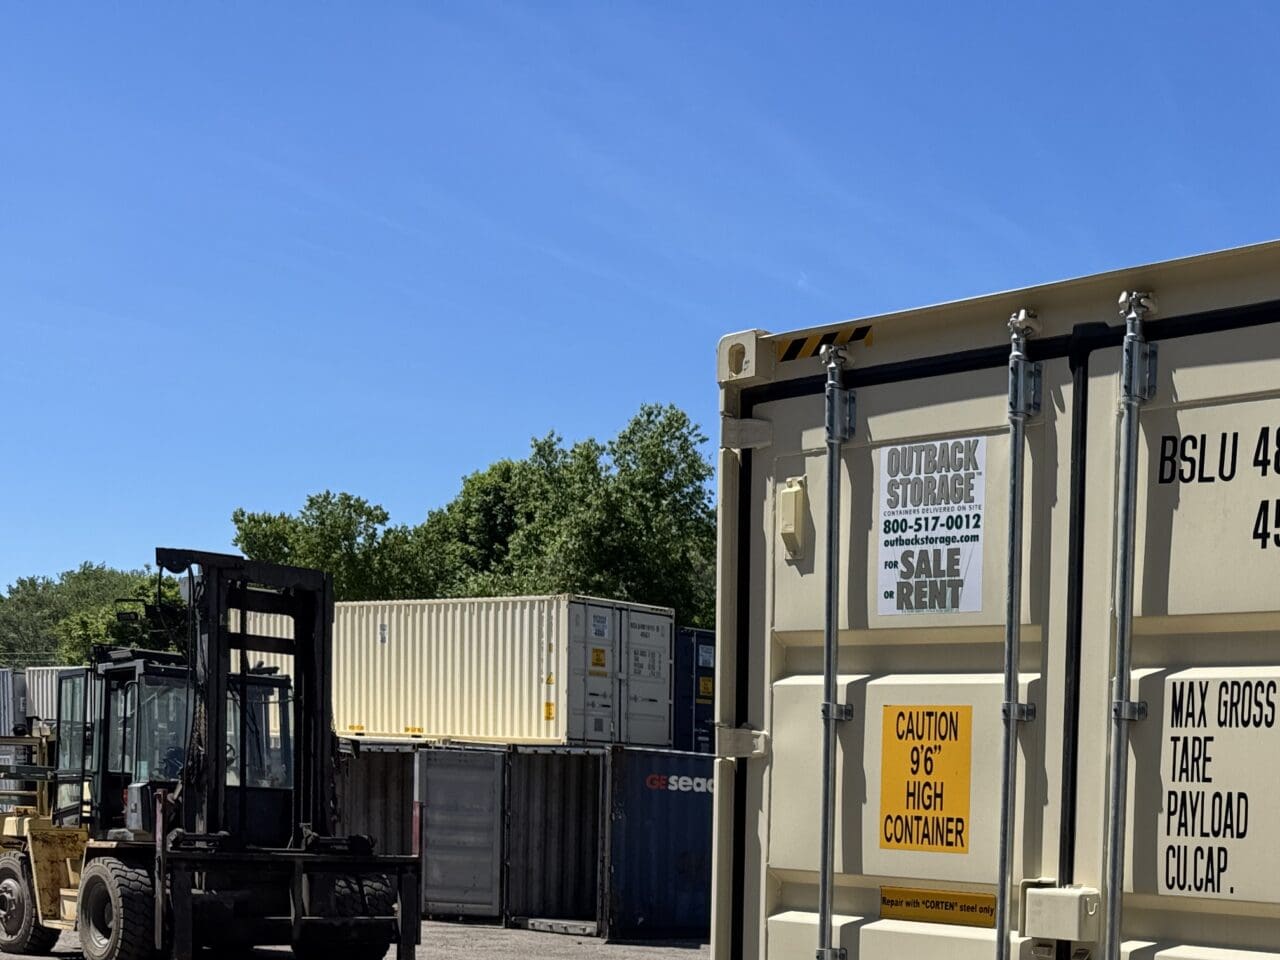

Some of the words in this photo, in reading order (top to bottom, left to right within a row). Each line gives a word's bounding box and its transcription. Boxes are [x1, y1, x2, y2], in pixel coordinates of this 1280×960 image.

[886, 439, 979, 478] OUTBACK
[1158, 431, 1239, 485] BSLU
[886, 472, 976, 509] STORAGE
[883, 508, 920, 517] CONTAINERS
[921, 505, 955, 514] DELIVERED
[883, 513, 981, 534] 800-517-0012
[883, 534, 979, 548] outbackstorage.com
[884, 561, 899, 569] FOR
[900, 548, 961, 580] SALE
[883, 591, 895, 599] OR
[896, 579, 964, 610] RENT
[1170, 681, 1209, 728] MAX
[1217, 680, 1277, 728] GROSS
[896, 711, 959, 741] CAUTION
[1170, 736, 1214, 783] TARE
[906, 781, 944, 811] HIGH
[1166, 790, 1249, 839] PAYLOAD
[884, 815, 965, 847] CONTAINER
[1165, 845, 1234, 894] CU.CAP.
[881, 896, 903, 908] Repair
[905, 898, 920, 908] with
[960, 903, 977, 913] steel
[979, 905, 994, 916] only
